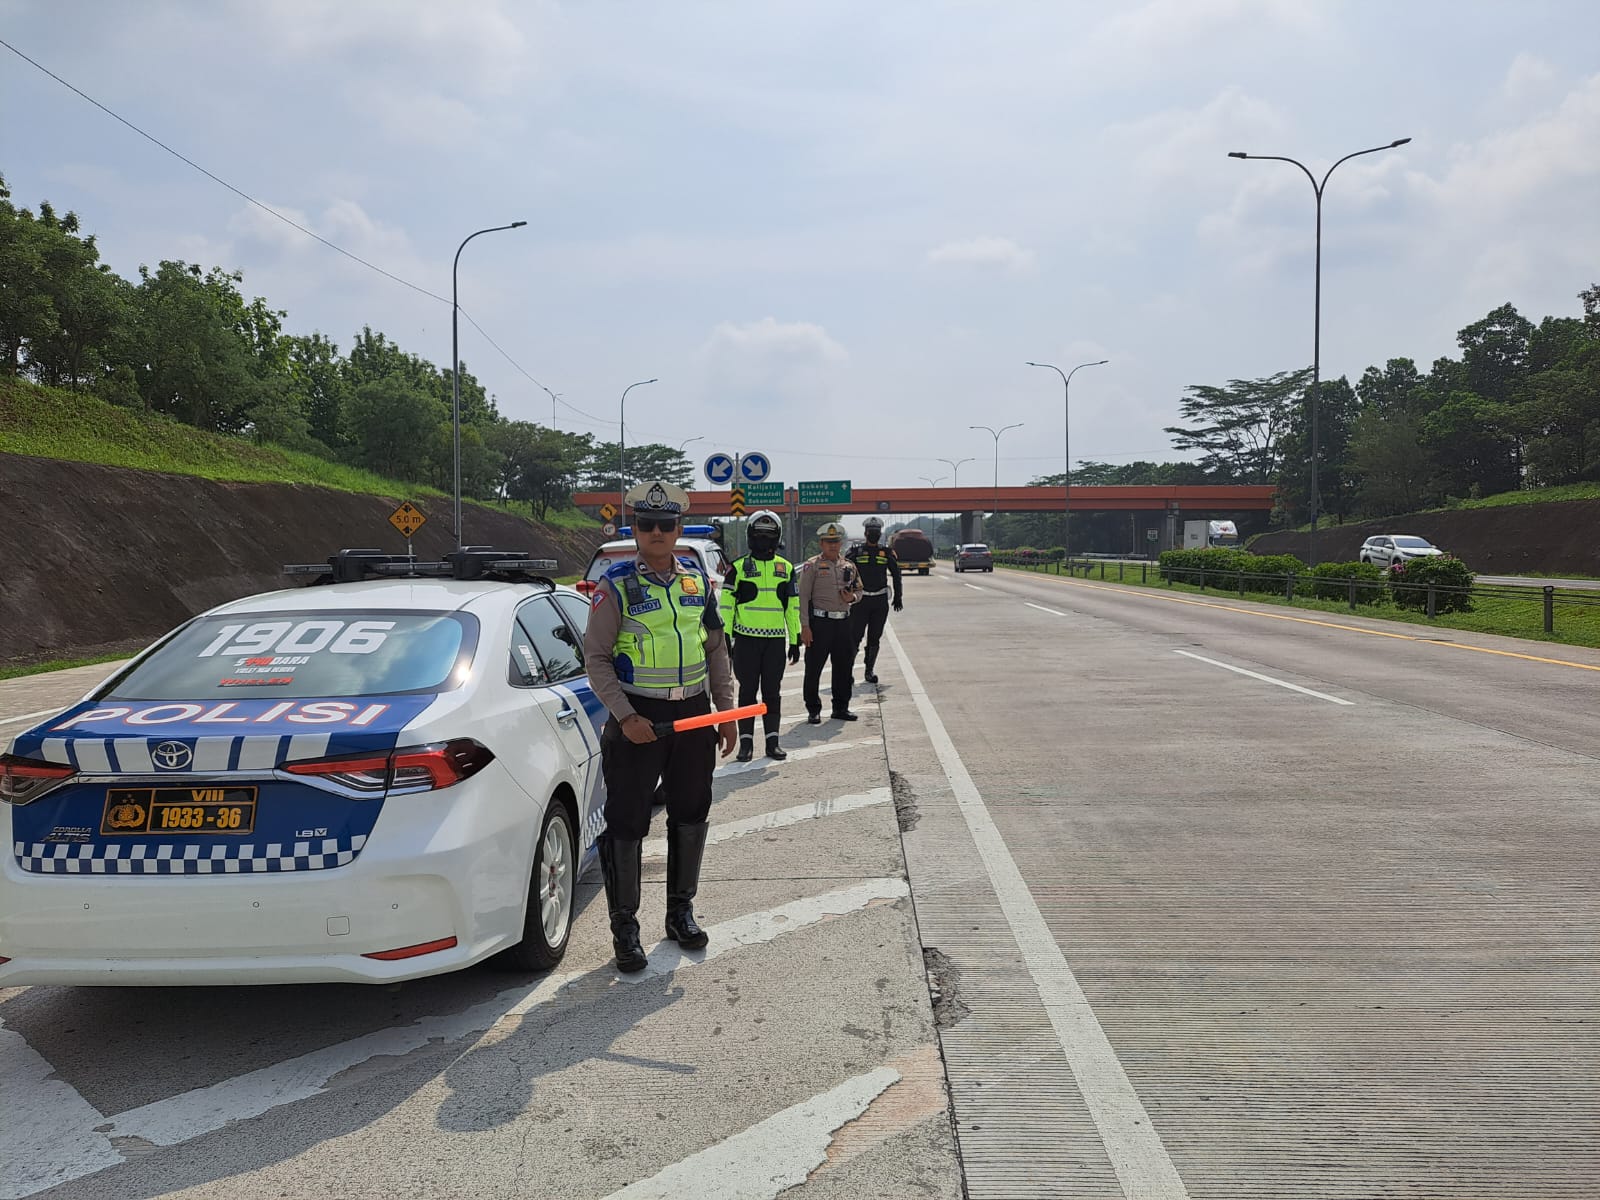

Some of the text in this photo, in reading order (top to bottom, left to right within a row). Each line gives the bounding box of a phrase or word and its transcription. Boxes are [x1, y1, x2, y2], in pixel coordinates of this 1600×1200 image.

[412, 516, 421, 524] m
[629, 601, 660, 615] RENDY
[198, 621, 397, 658] 1906
[50, 702, 391, 731] POLISI
[191, 789, 224, 802] VIII
